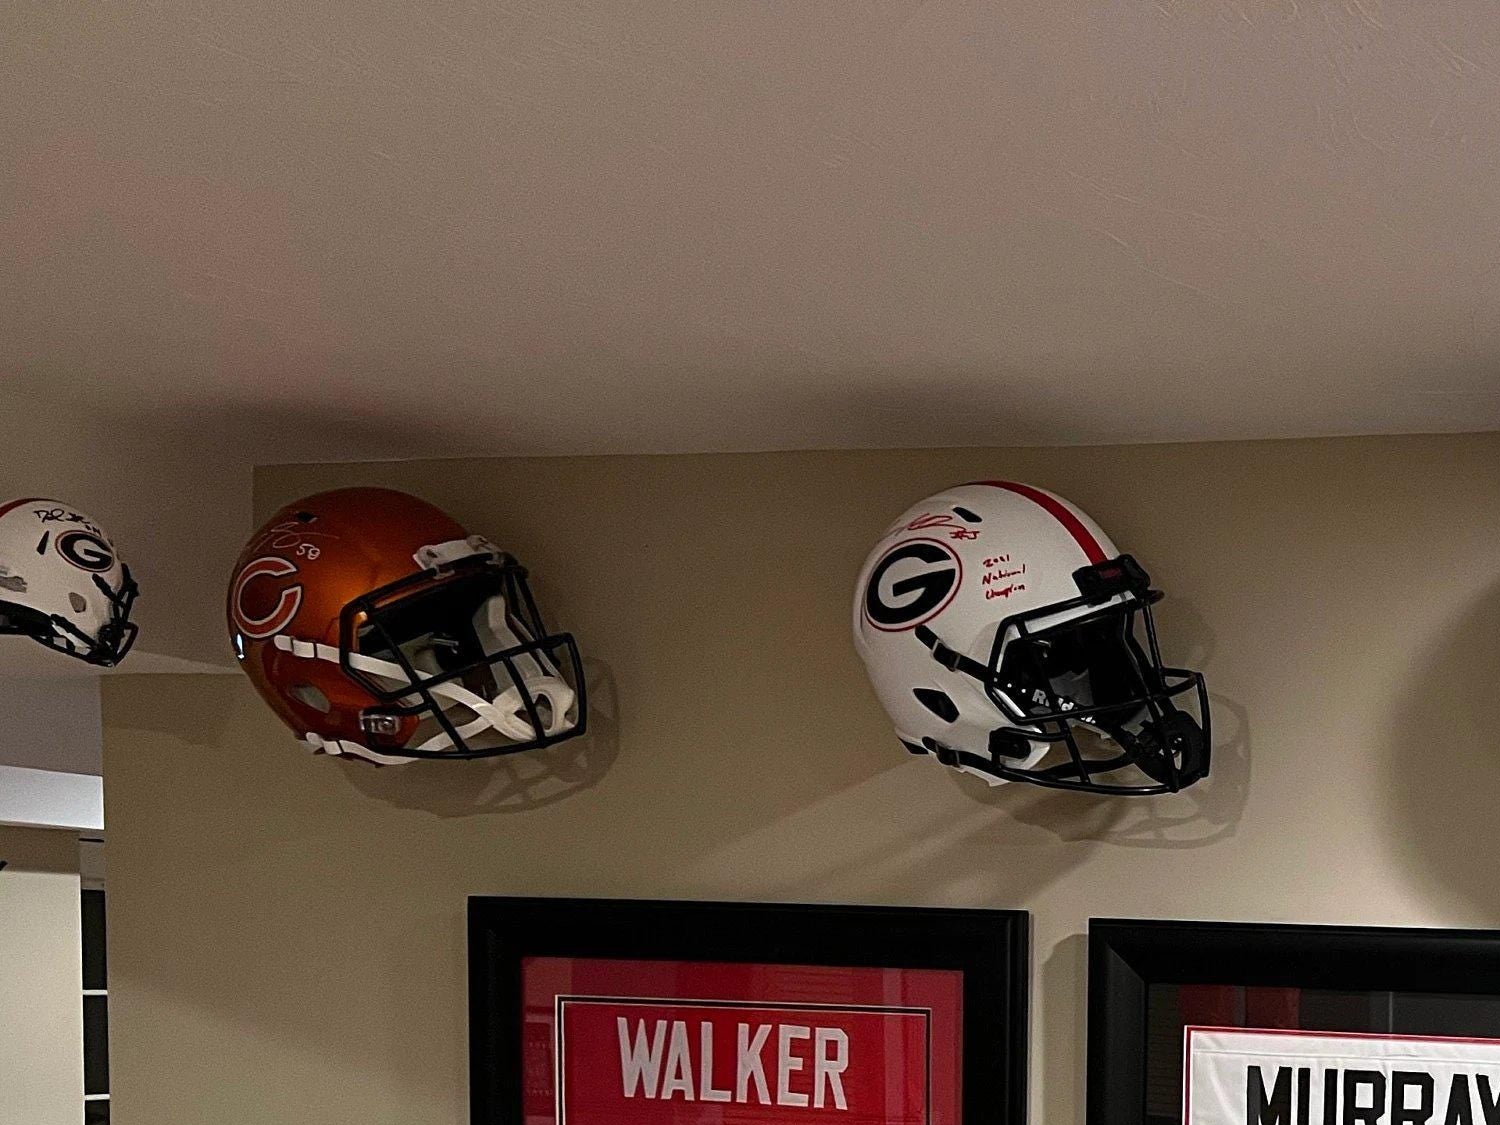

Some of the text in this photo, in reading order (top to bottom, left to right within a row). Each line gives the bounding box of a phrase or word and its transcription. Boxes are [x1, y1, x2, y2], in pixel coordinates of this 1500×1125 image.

[60, 533, 113, 570] G
[866, 543, 957, 625] G
[231, 556, 302, 639] C
[616, 1016, 850, 1111] WALKER
